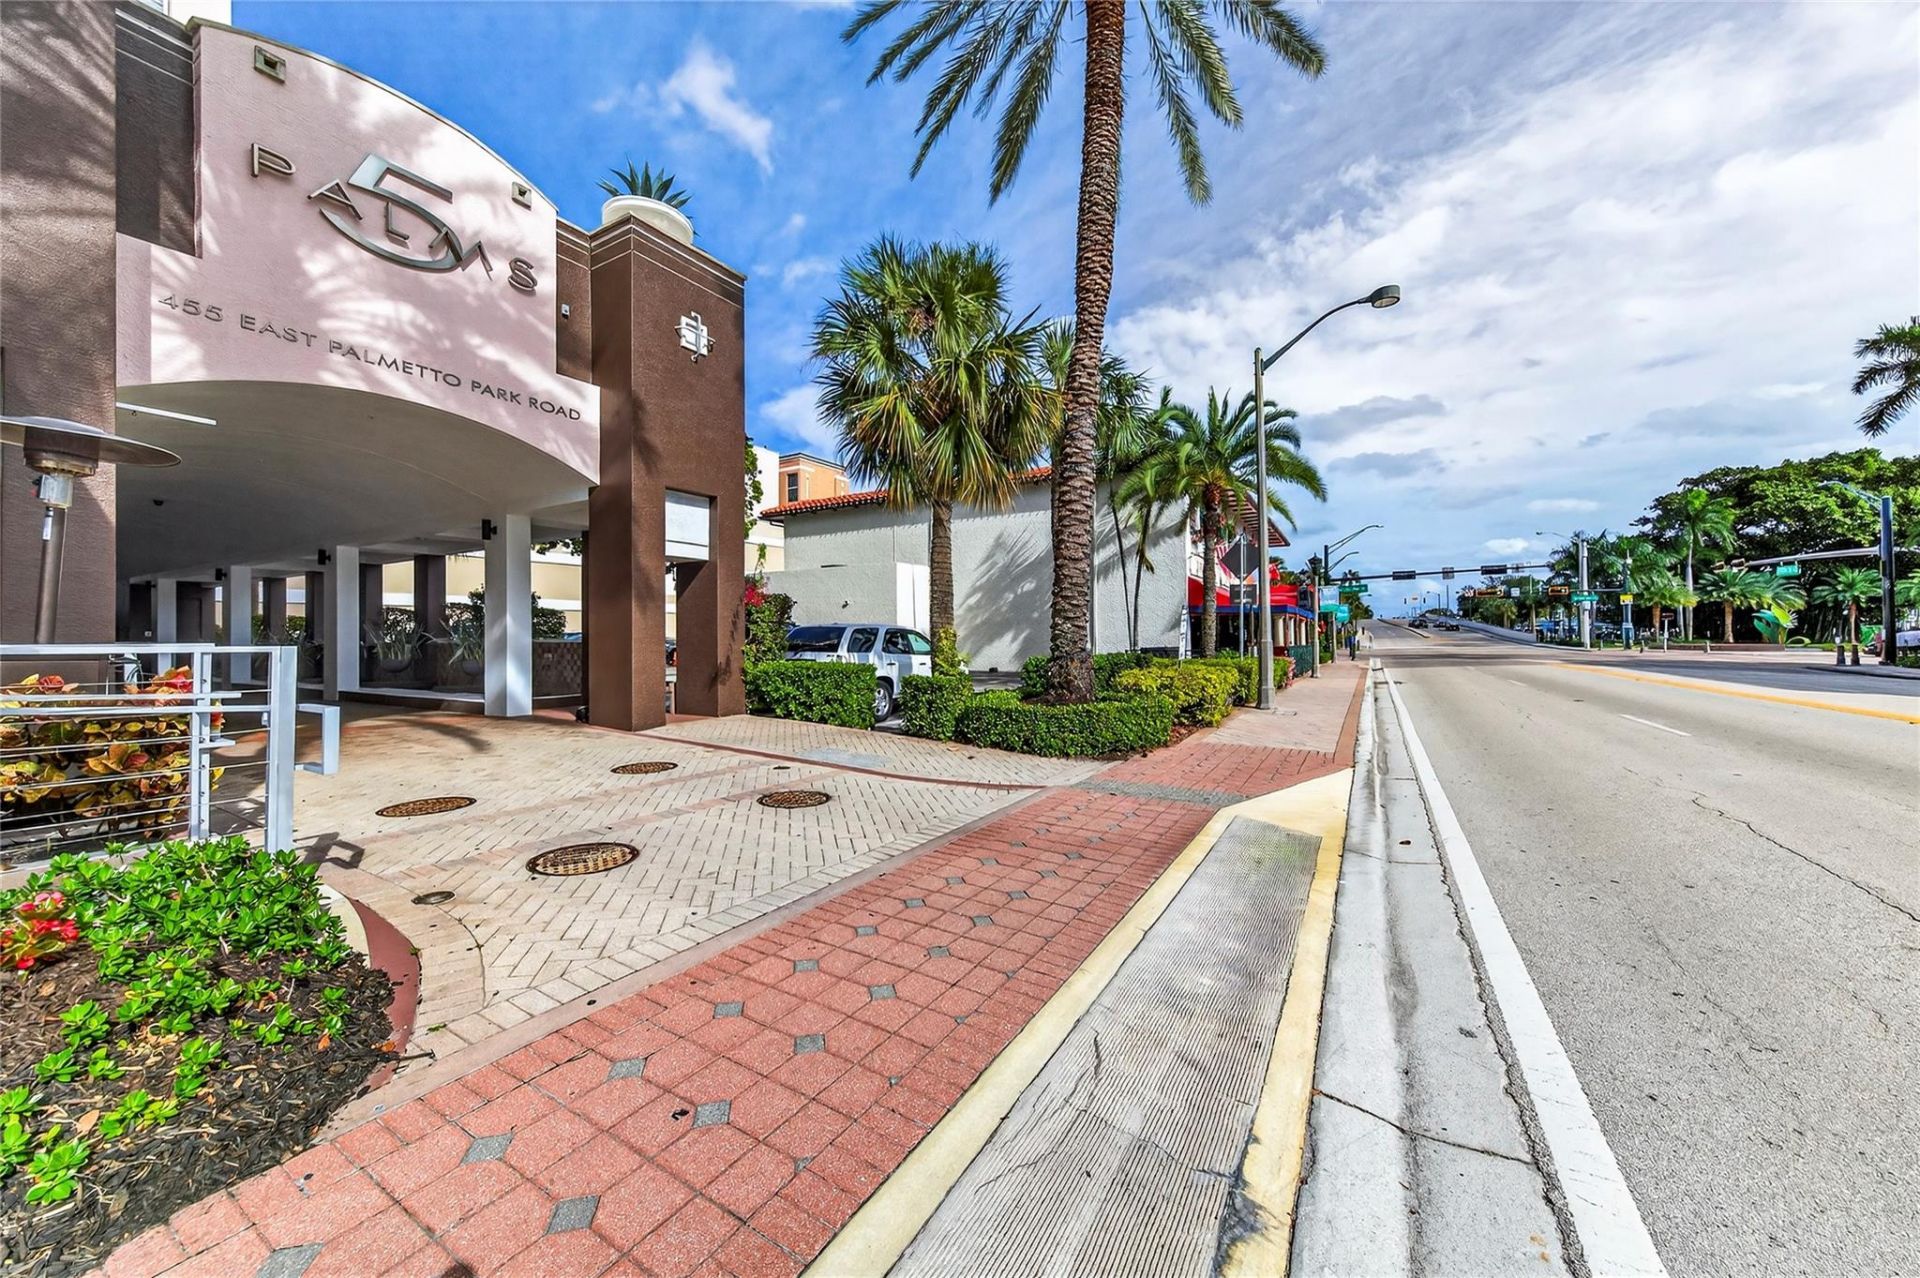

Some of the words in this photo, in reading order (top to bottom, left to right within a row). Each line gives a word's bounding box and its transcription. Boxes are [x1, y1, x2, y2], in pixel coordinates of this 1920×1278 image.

[251, 142, 538, 291] PALMS
[319, 153, 463, 273] 5
[158, 294, 223, 322] 455
[240, 313, 317, 347] EAST
[329, 339, 461, 387] PALMETTO
[471, 380, 522, 406] PARK
[529, 397, 581, 421] ROAD
